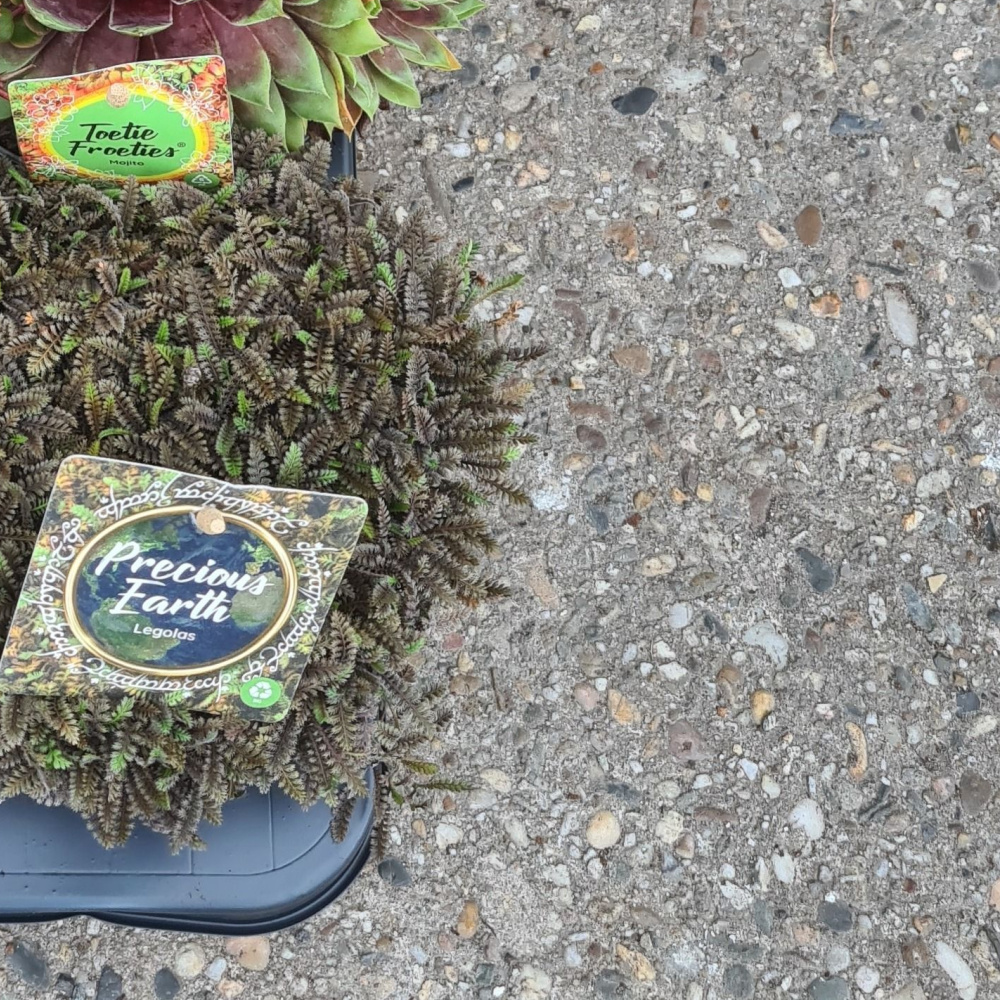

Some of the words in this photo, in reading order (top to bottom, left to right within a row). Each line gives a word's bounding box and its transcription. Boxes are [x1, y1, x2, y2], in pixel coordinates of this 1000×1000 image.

[80, 122, 159, 142] Toetie
[68, 140, 180, 157] Froeties
[109, 159, 144, 167] Mojito
[94, 540, 275, 596] Precious
[109, 577, 232, 624] Earth
[133, 623, 197, 642] Legolas
